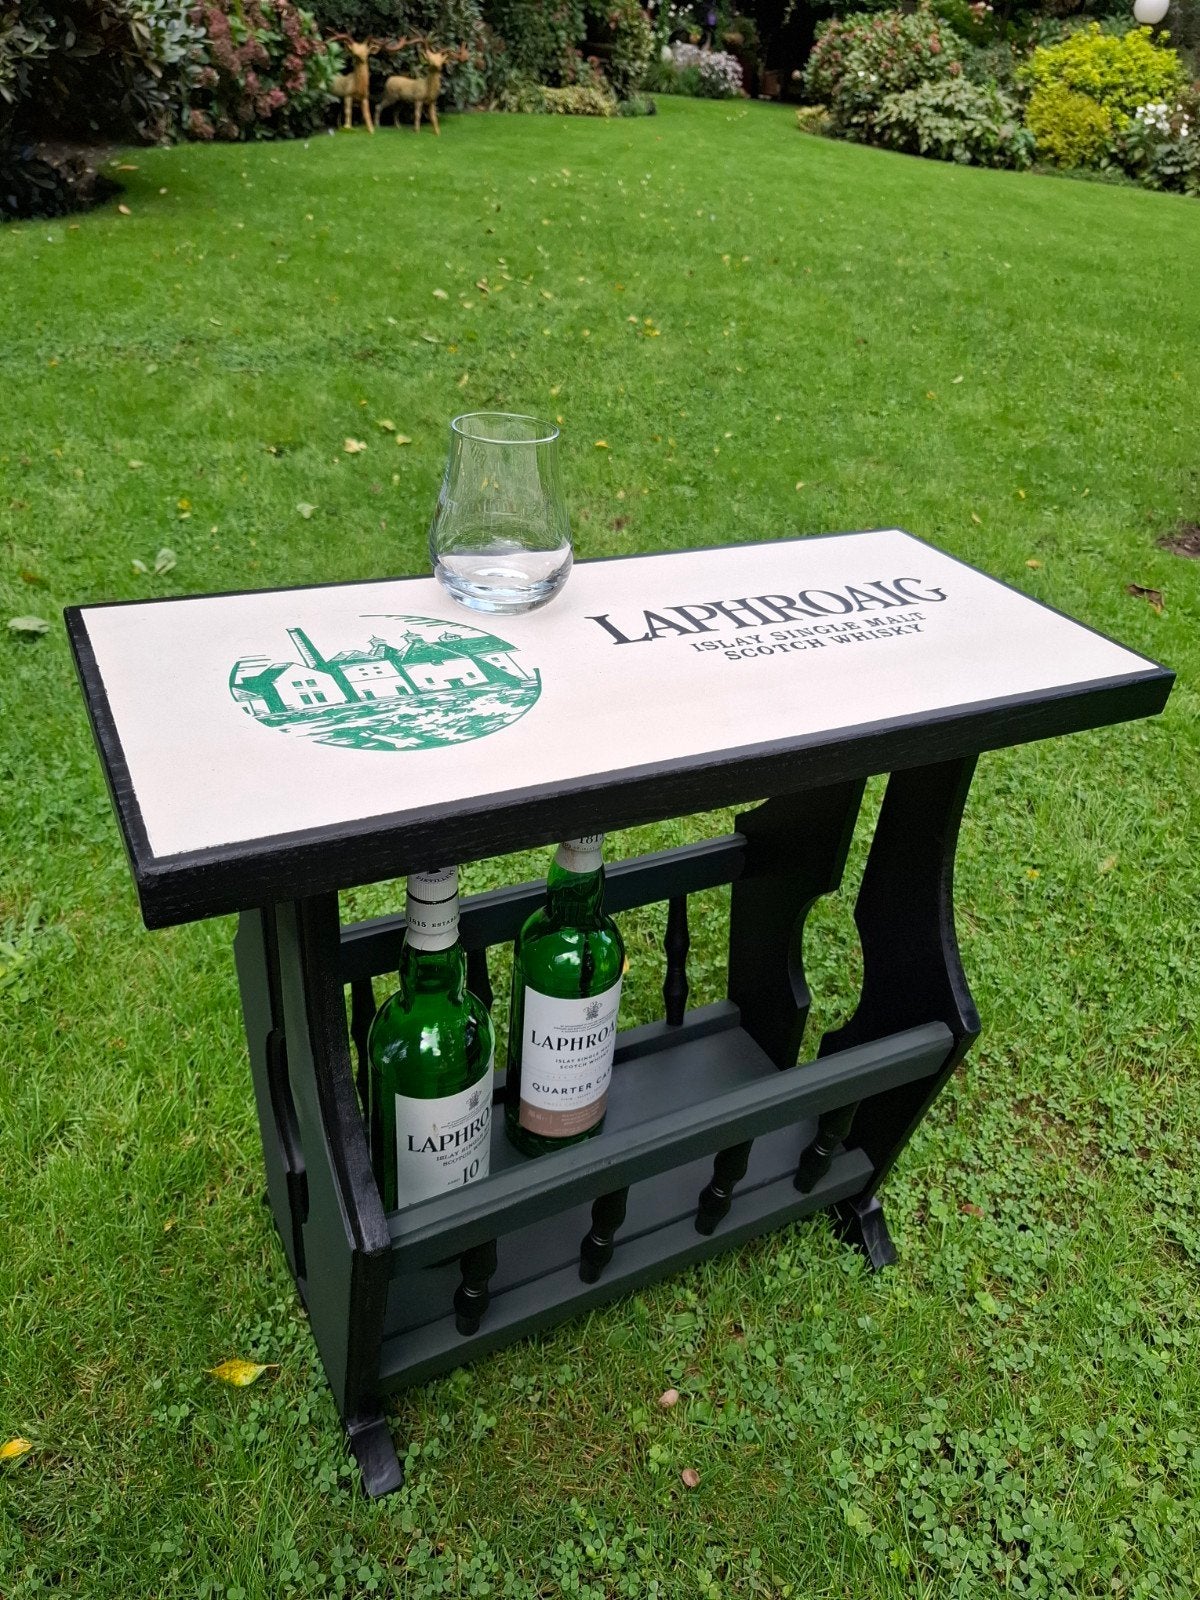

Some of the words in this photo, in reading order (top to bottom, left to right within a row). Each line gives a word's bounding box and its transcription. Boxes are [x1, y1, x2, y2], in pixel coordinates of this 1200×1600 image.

[585, 577, 948, 645] LAPHROAIG
[690, 634, 764, 652] ISLAY
[771, 621, 861, 641] SINGLE
[864, 611, 927, 627] MALT
[724, 636, 828, 660] SCOTCH
[830, 623, 925, 644] WHISKY
[560, 1062, 587, 1070] SCOTCH
[532, 1082, 592, 1095] QUARTER
[407, 1106, 489, 1153] LAPHRO
[463, 1158, 480, 1184] 10
